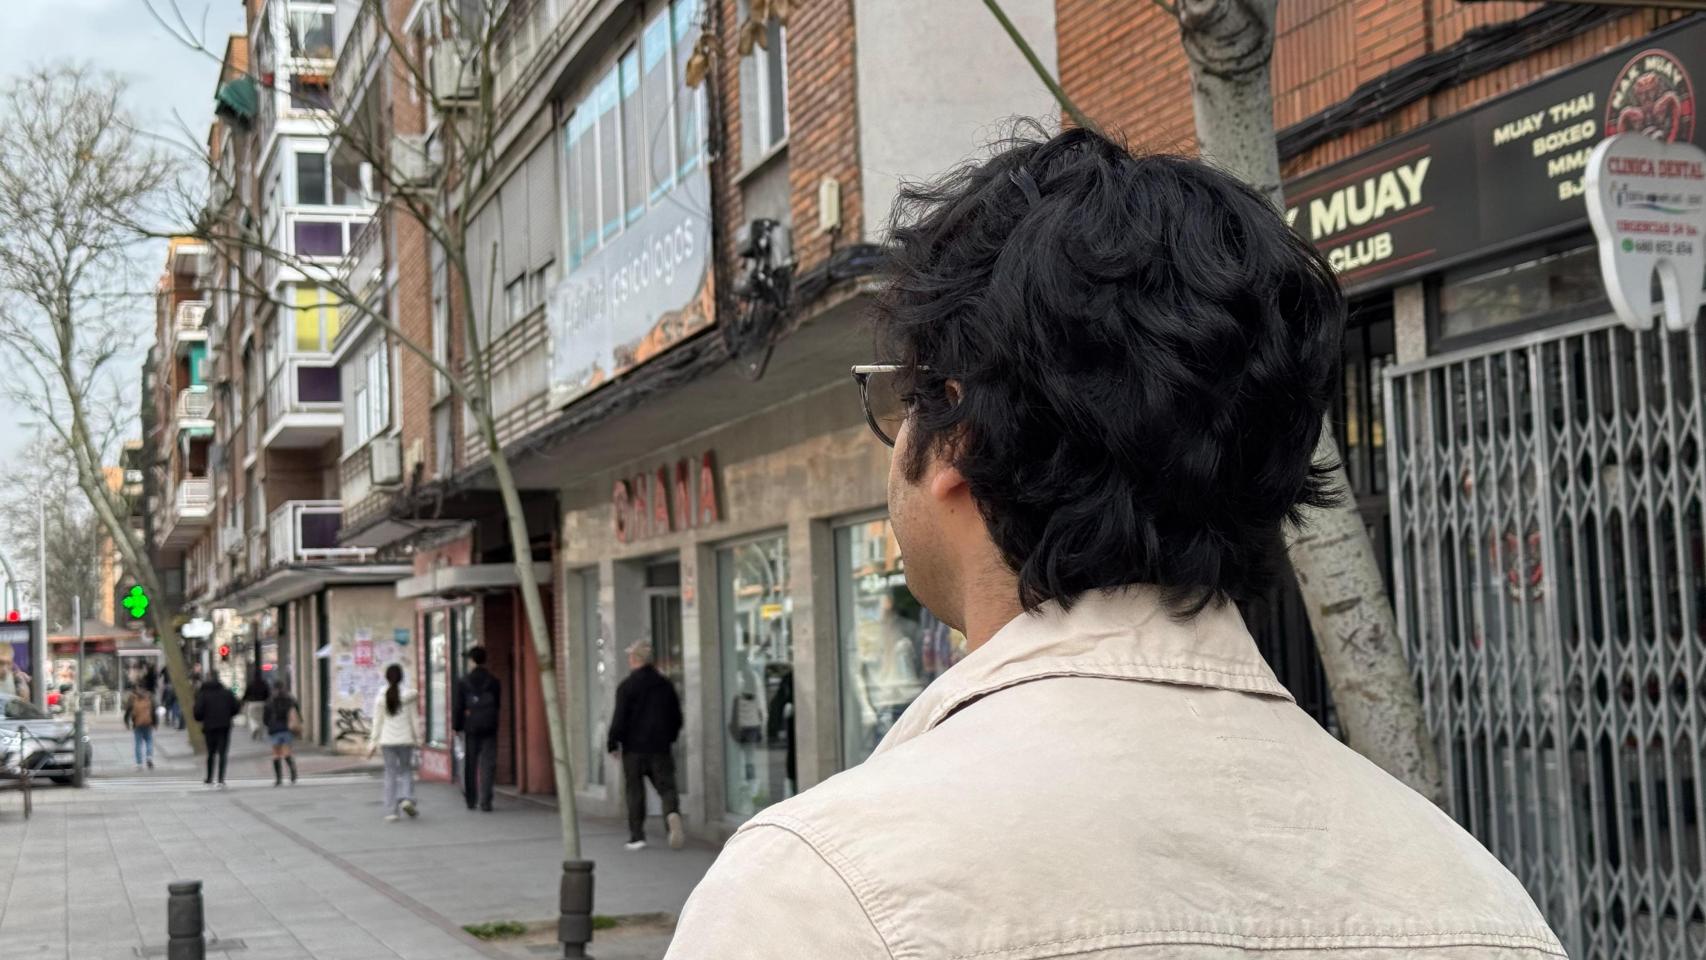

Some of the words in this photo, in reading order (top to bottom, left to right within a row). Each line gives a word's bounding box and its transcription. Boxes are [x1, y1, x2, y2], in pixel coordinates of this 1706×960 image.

[1645, 55, 1682, 86] MUAY
[1493, 110, 1546, 147] MUAY
[1548, 91, 1595, 125] THAI
[1532, 119, 1596, 157] BOXEO
[1606, 156, 1656, 177] CLINICA
[1657, 159, 1705, 181] DENTAL
[1310, 156, 1432, 241] MUAY
[1327, 231, 1394, 274] CLUB
